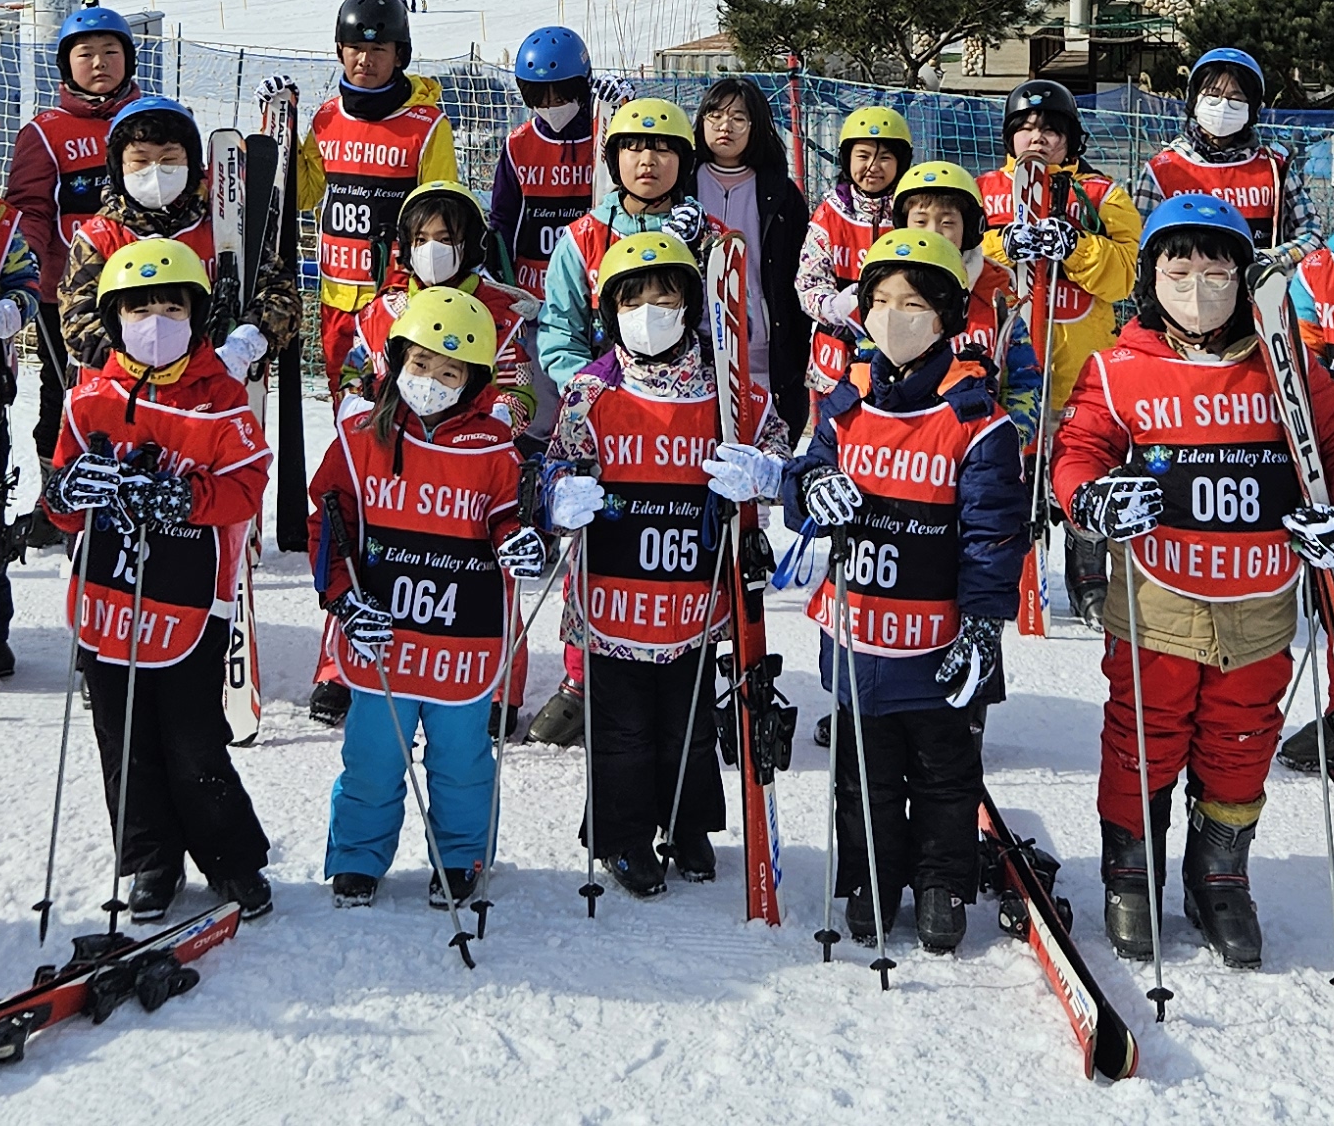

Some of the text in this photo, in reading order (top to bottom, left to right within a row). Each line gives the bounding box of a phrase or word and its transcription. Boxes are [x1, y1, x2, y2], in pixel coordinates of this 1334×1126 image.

[64, 137, 99, 161] SKI
[318, 140, 410, 169] SKI SCHOOL
[227, 147, 236, 203] HEAD
[518, 165, 544, 186] SKI
[347, 184, 373, 199] Valley
[374, 186, 405, 199] Resort
[984, 193, 1012, 216] SKI
[1211, 186, 1274, 208] CHOO
[331, 201, 371, 234] 083
[533, 208, 556, 218] Eden
[833, 245, 851, 269] KI
[716, 301, 724, 351] HEAD
[1134, 392, 1282, 431] SKI SCHOO
[1271, 332, 1320, 483] HEAD
[603, 434, 718, 468] SKI SCHO
[1176, 448, 1290, 468] Eden Valley Reso
[859, 444, 957, 488] SCHOOL
[366, 475, 407, 511] SKI
[630, 499, 673, 516] Eden
[1190, 476, 1261, 523] 068
[159, 521, 203, 540] Resort
[864, 512, 904, 535] Valley
[905, 518, 948, 536] Resort
[384, 546, 421, 566] Eden
[423, 551, 464, 573] Valley
[638, 527, 700, 572] 065
[1143, 537, 1292, 580] ONEEIGHT
[390, 575, 458, 626] 064
[759, 862, 769, 922] HEAD
[193, 925, 230, 950] HEAD
